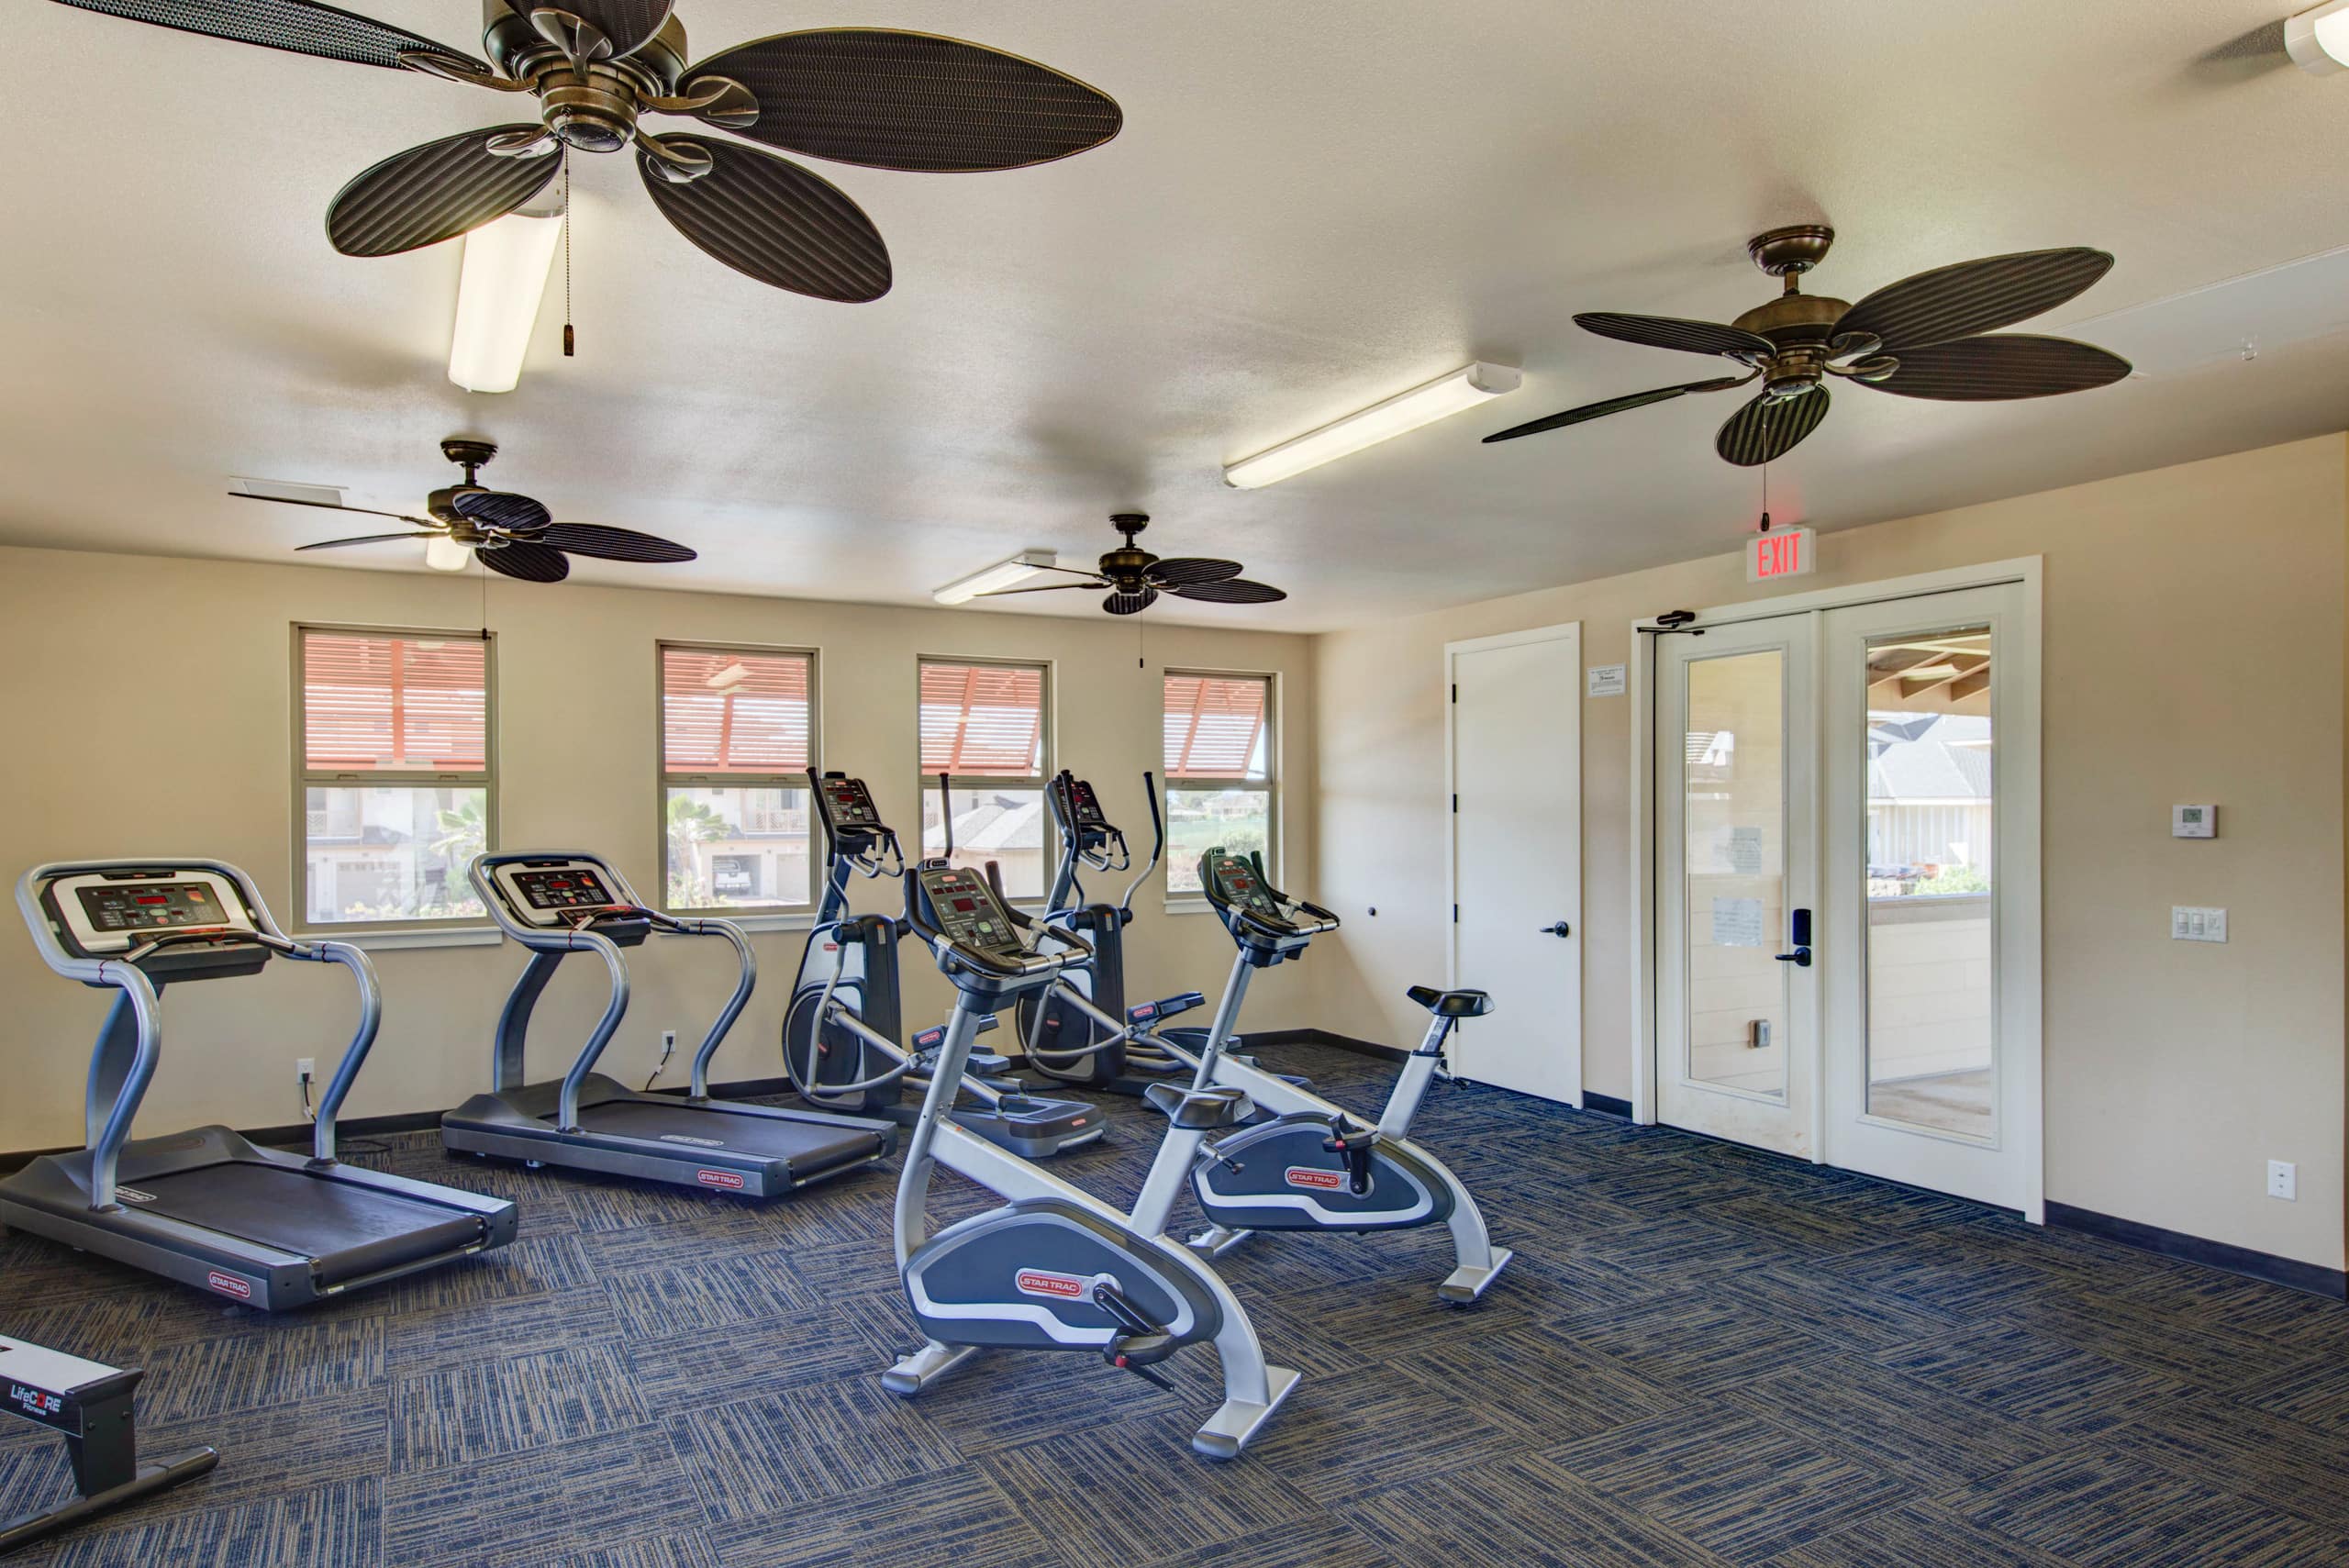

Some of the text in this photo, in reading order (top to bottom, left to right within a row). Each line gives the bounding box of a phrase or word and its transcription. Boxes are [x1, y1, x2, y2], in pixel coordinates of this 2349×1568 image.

[1757, 532, 1801, 578] EXIT
[700, 1173, 740, 1185] STAR TRAC
[1291, 1173, 1337, 1184] STAR TRAC
[211, 1276, 248, 1293] STAR TRAC
[1023, 1278, 1077, 1292] STAR TRAC
[10, 1385, 61, 1413] LifeCORE
